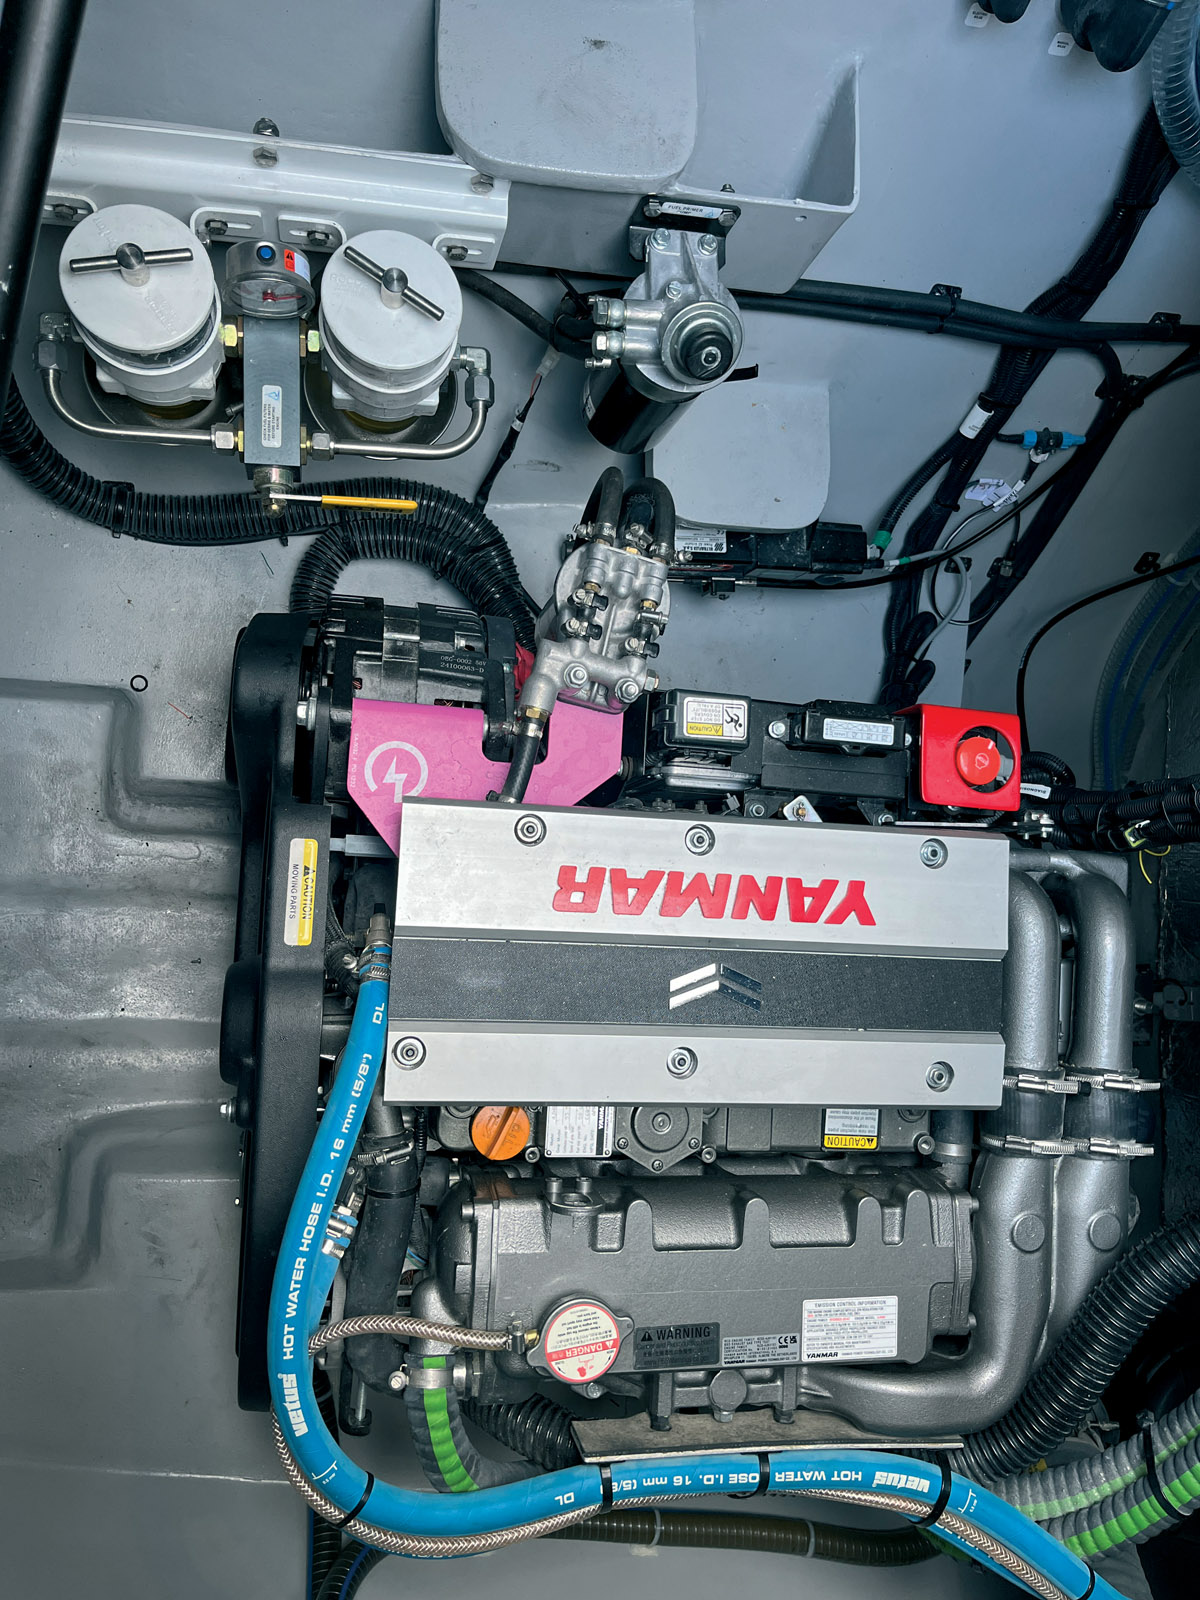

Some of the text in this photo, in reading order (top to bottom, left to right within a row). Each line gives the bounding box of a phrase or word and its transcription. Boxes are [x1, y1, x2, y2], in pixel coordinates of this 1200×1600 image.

[288, 863, 299, 919] MOVING PARTS
[301, 877, 314, 920] CAUTION
[551, 864, 877, 926] YANMAR
[827, 1136, 866, 1147] CAUTION
[281, 1002, 385, 1438] vetus HOT WATER HOSE I.D. 16 mm (5/8") DL
[565, 1343, 603, 1357] DANGER
[656, 1326, 711, 1341] WARNING
[554, 1470, 931, 1506] vetus HOT WATER OSE I.D. 16 mm (5/8) DL
